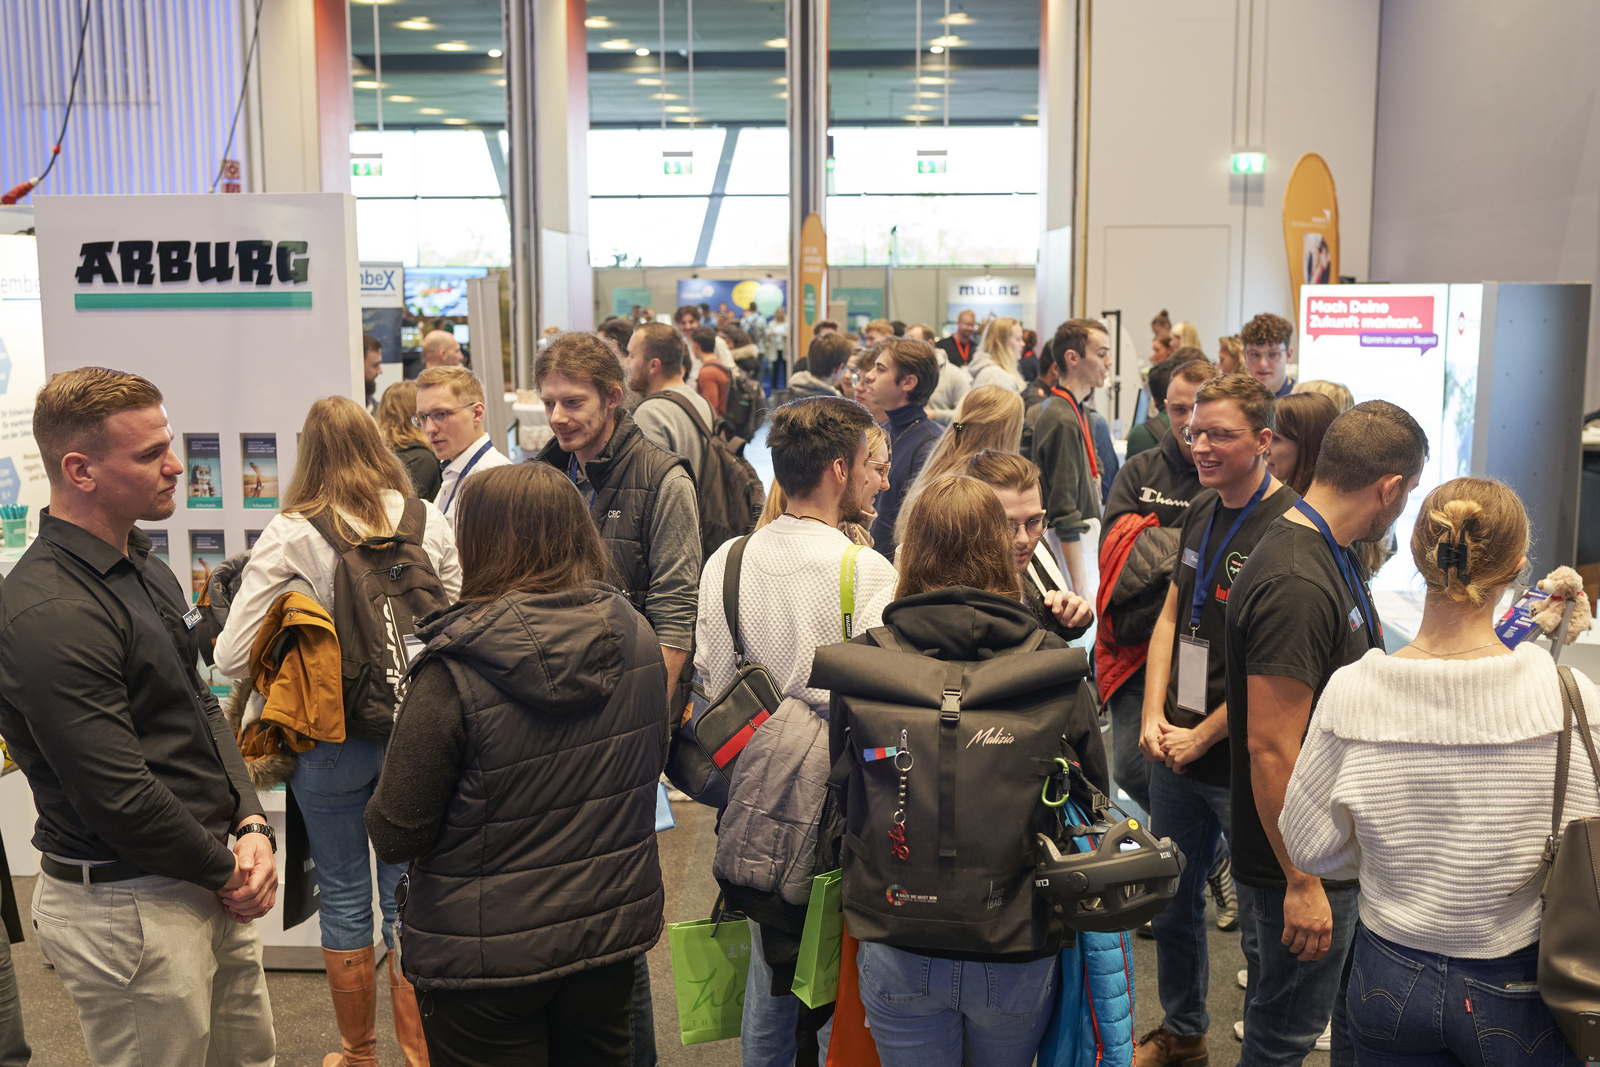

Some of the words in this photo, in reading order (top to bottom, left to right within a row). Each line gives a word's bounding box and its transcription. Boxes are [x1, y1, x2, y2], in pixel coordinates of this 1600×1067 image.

[74, 240, 310, 286] ARBURG
[1310, 300, 1348, 313] Mach
[1349, 300, 1390, 314] Deine
[1309, 315, 1360, 328] Zukunft
[1361, 315, 1423, 329] markant.
[966, 726, 1015, 749] Malizia
